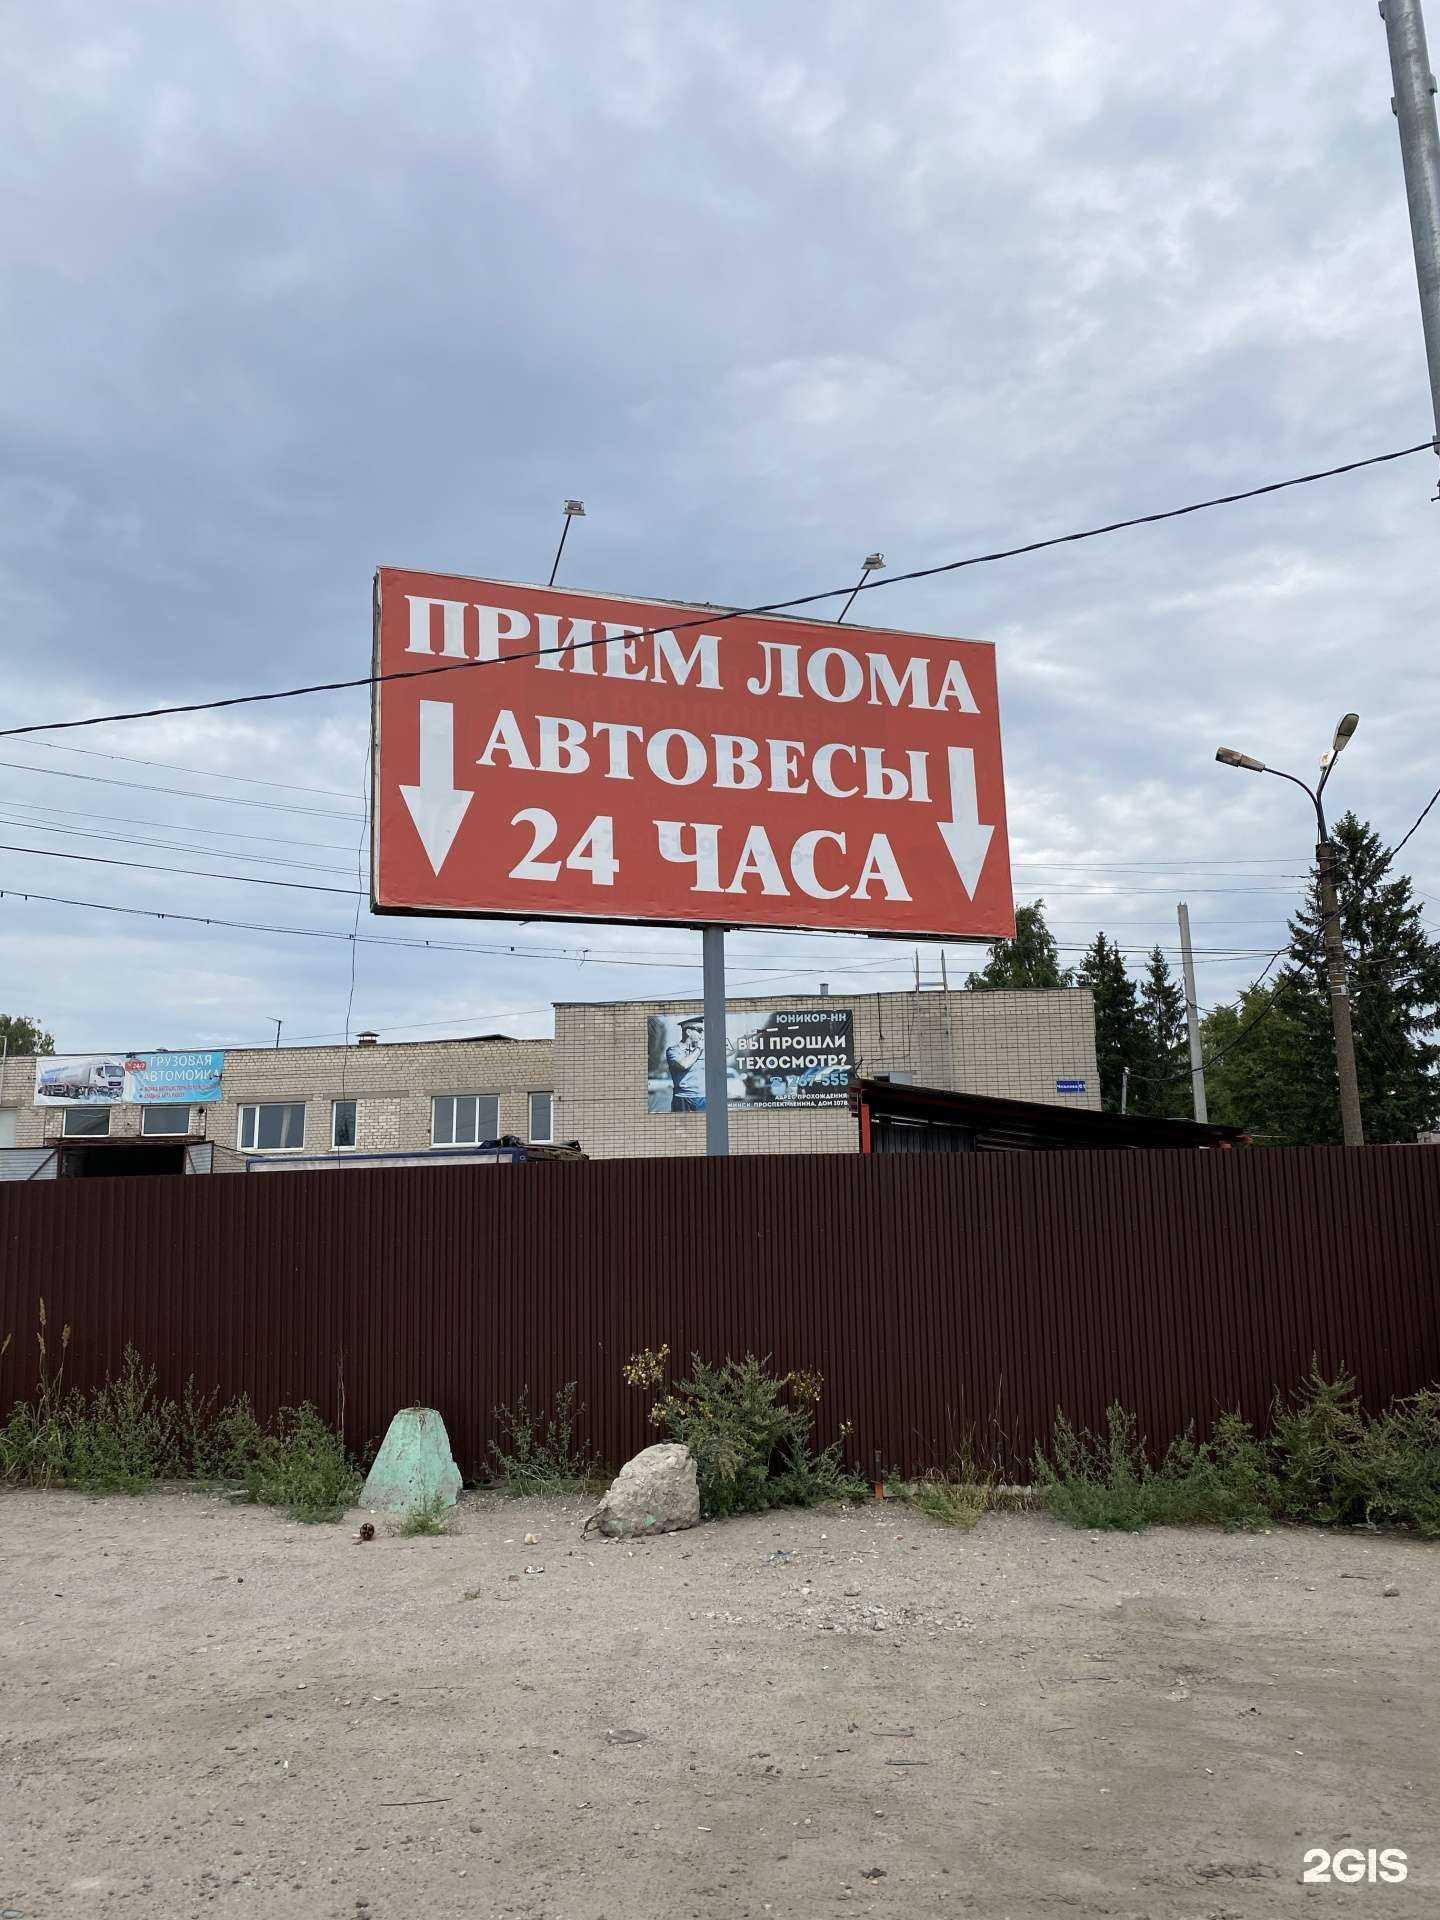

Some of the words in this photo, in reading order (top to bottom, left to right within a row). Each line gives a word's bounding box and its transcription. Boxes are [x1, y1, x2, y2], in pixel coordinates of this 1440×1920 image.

[404, 594, 723, 690] ПРИЕМ
[747, 640, 981, 714] ЛОМА
[476, 708, 933, 803] АВТОВЕСЫ
[508, 806, 620, 886] 24
[652, 819, 914, 902] ЧАСА
[776, 1013, 847, 1024] ЮНИКОР-НН
[738, 1037, 764, 1051] ВЫ
[769, 1035, 846, 1050] ПРОШЛИ
[150, 1055, 212, 1067] ГРУЗОВАЯ
[736, 1054, 848, 1070] ТЕХОСМОТР?
[143, 1067, 220, 1082] АВТОМОЙКА
